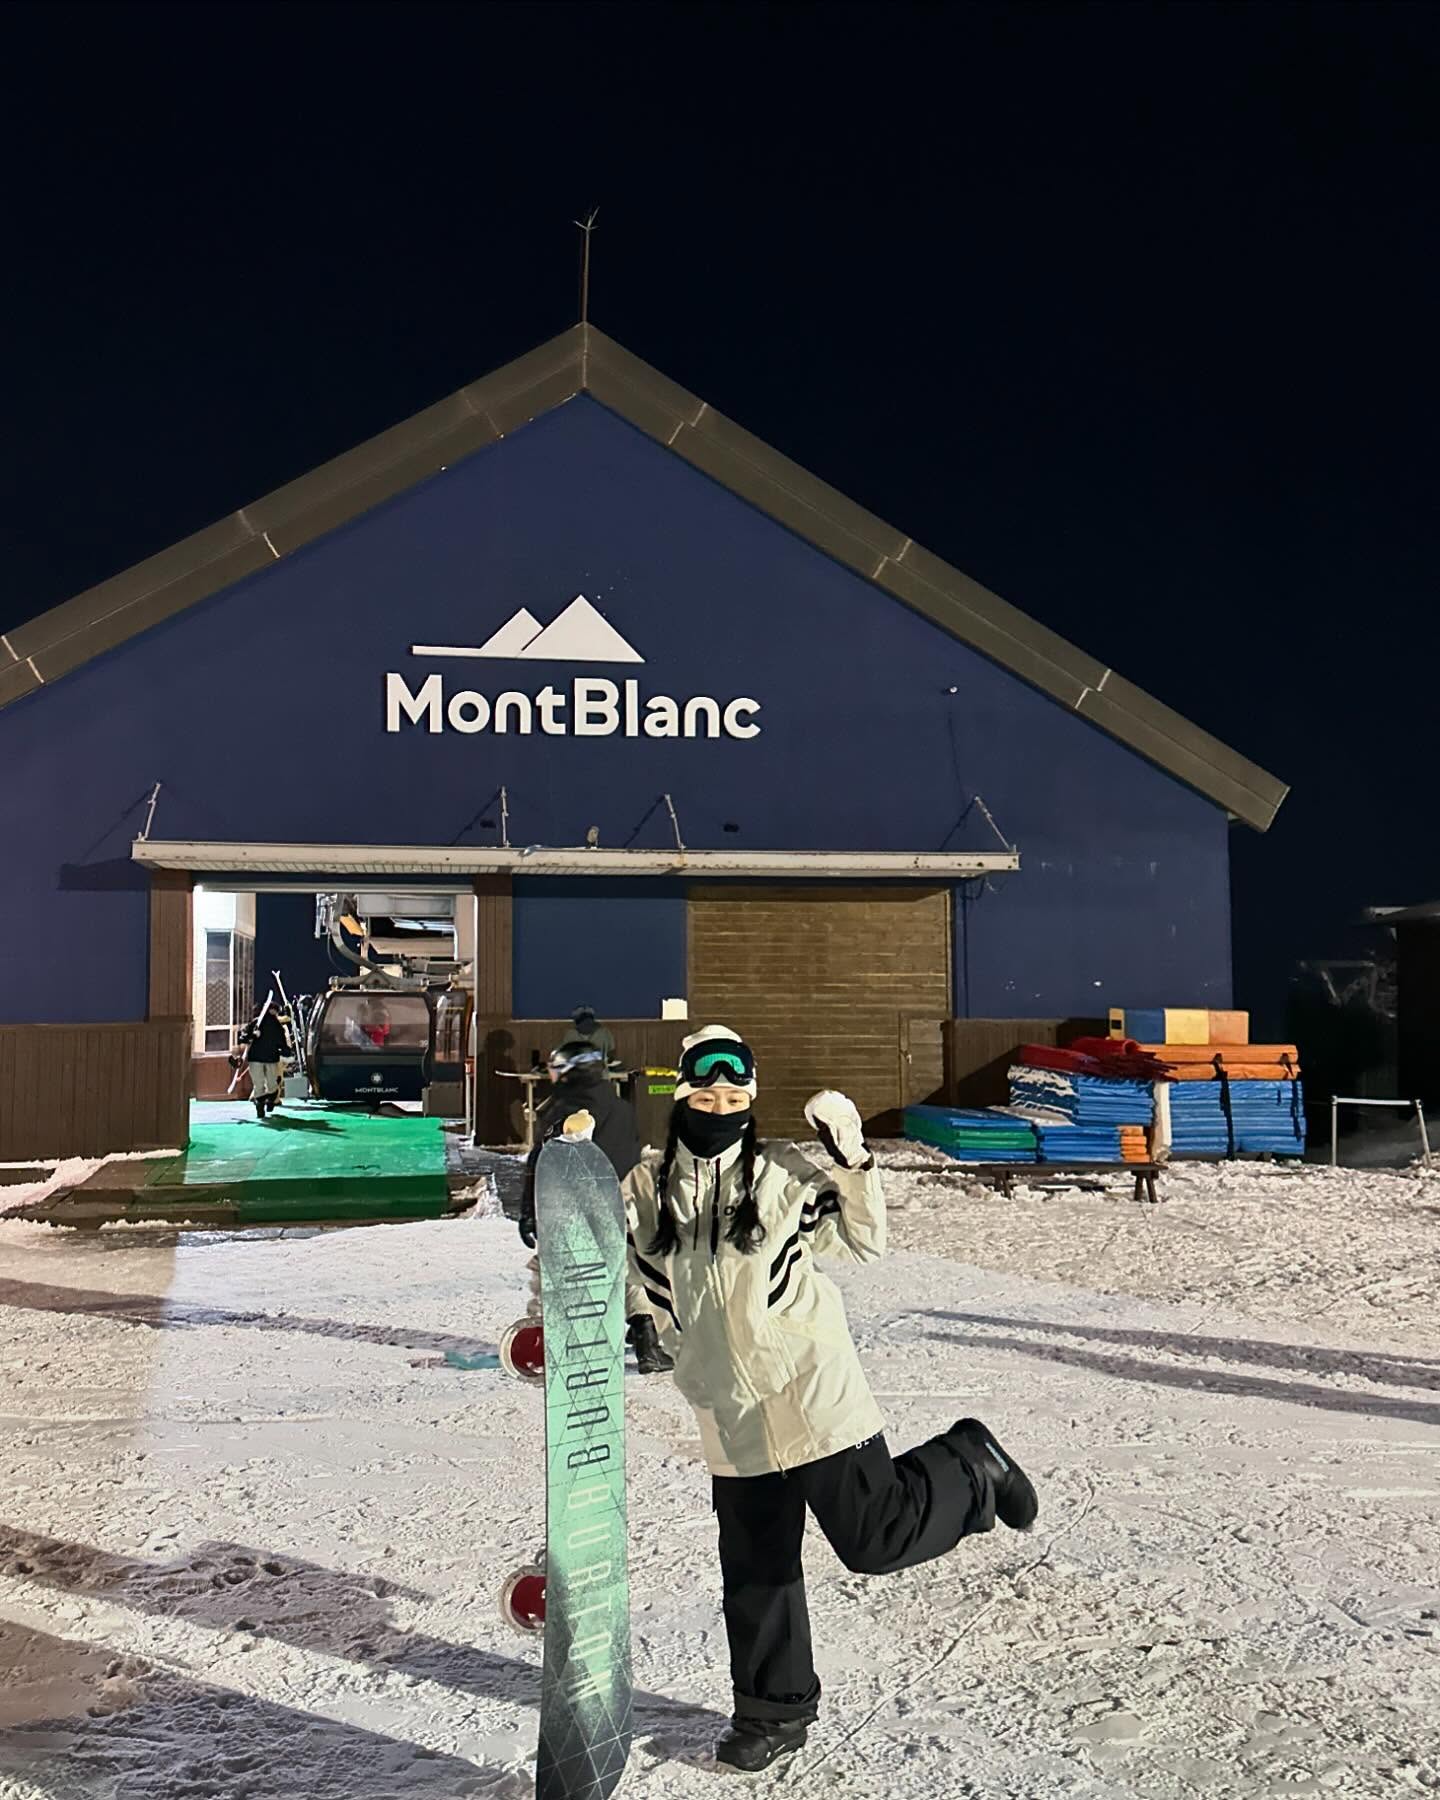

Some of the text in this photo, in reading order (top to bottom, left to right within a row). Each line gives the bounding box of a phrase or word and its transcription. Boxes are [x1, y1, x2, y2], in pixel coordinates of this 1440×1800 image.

[386, 673, 761, 739] MontBlanc
[354, 1086, 399, 1094] MONTBLANC
[564, 1260, 611, 1470] BURTON
[567, 1484, 612, 1704] BURTON
